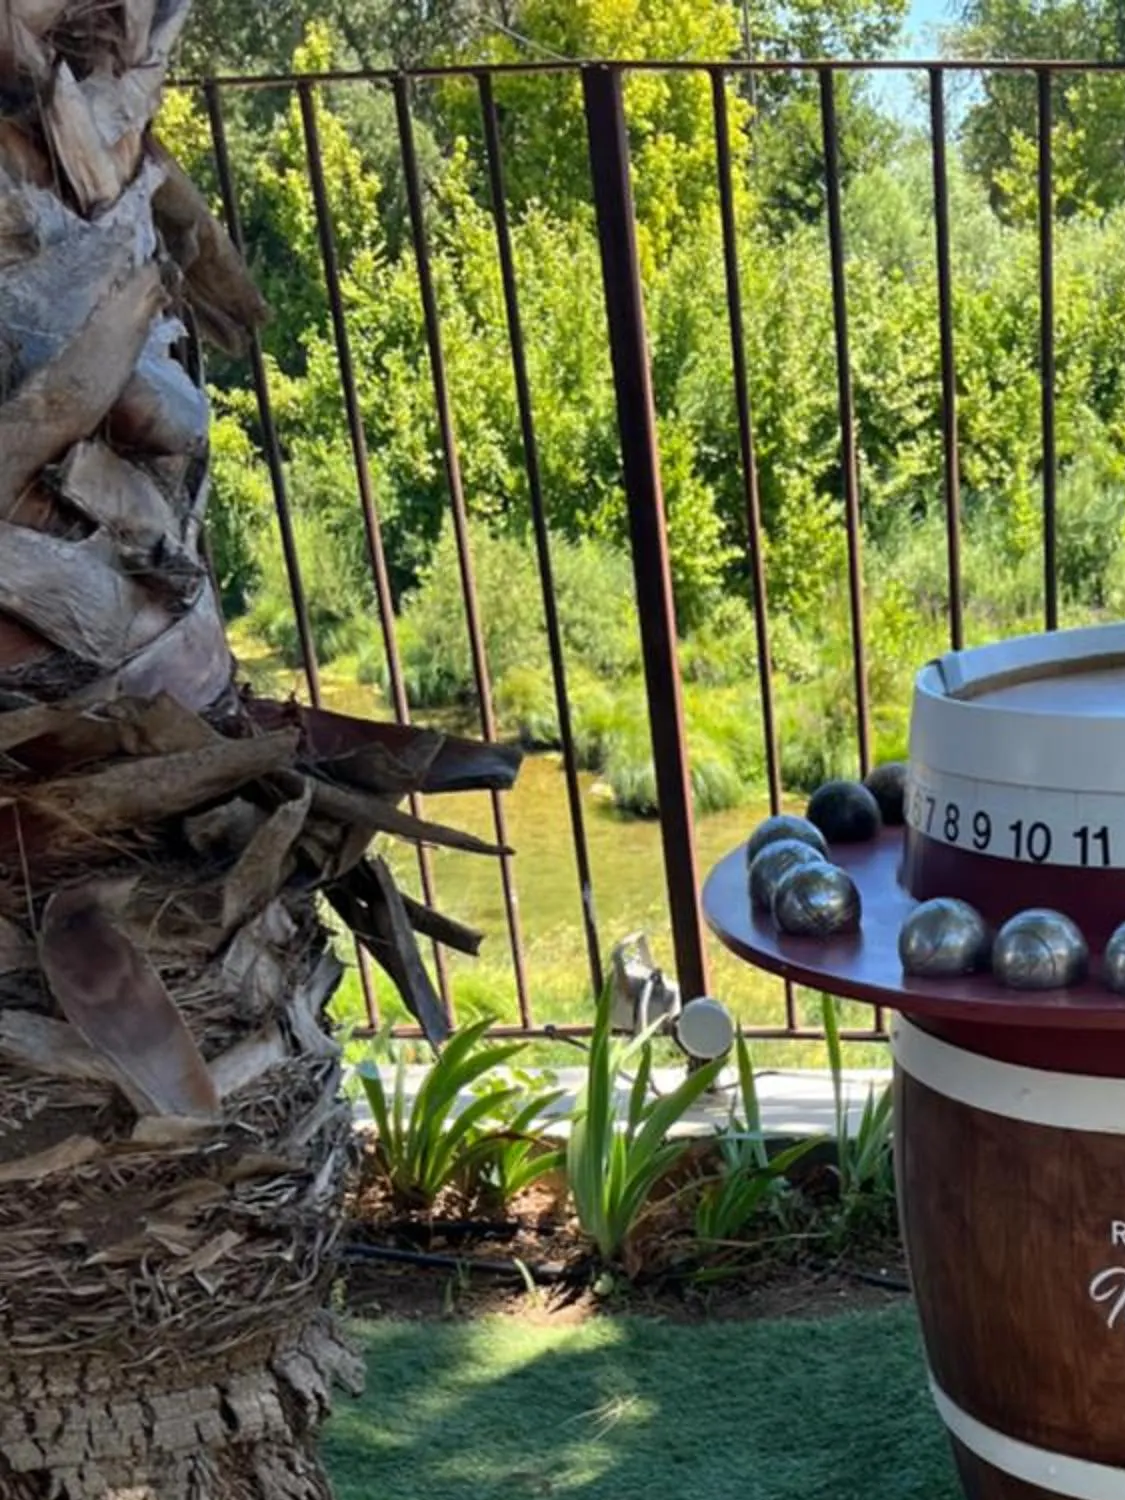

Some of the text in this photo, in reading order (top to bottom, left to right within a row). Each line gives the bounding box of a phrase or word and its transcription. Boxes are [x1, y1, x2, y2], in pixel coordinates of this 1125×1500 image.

[926, 797, 936, 833] 7
[944, 803, 960, 841] 8
[972, 811, 992, 849] 9
[1009, 820, 1052, 863] 10
[1073, 826, 1111, 866] 11
